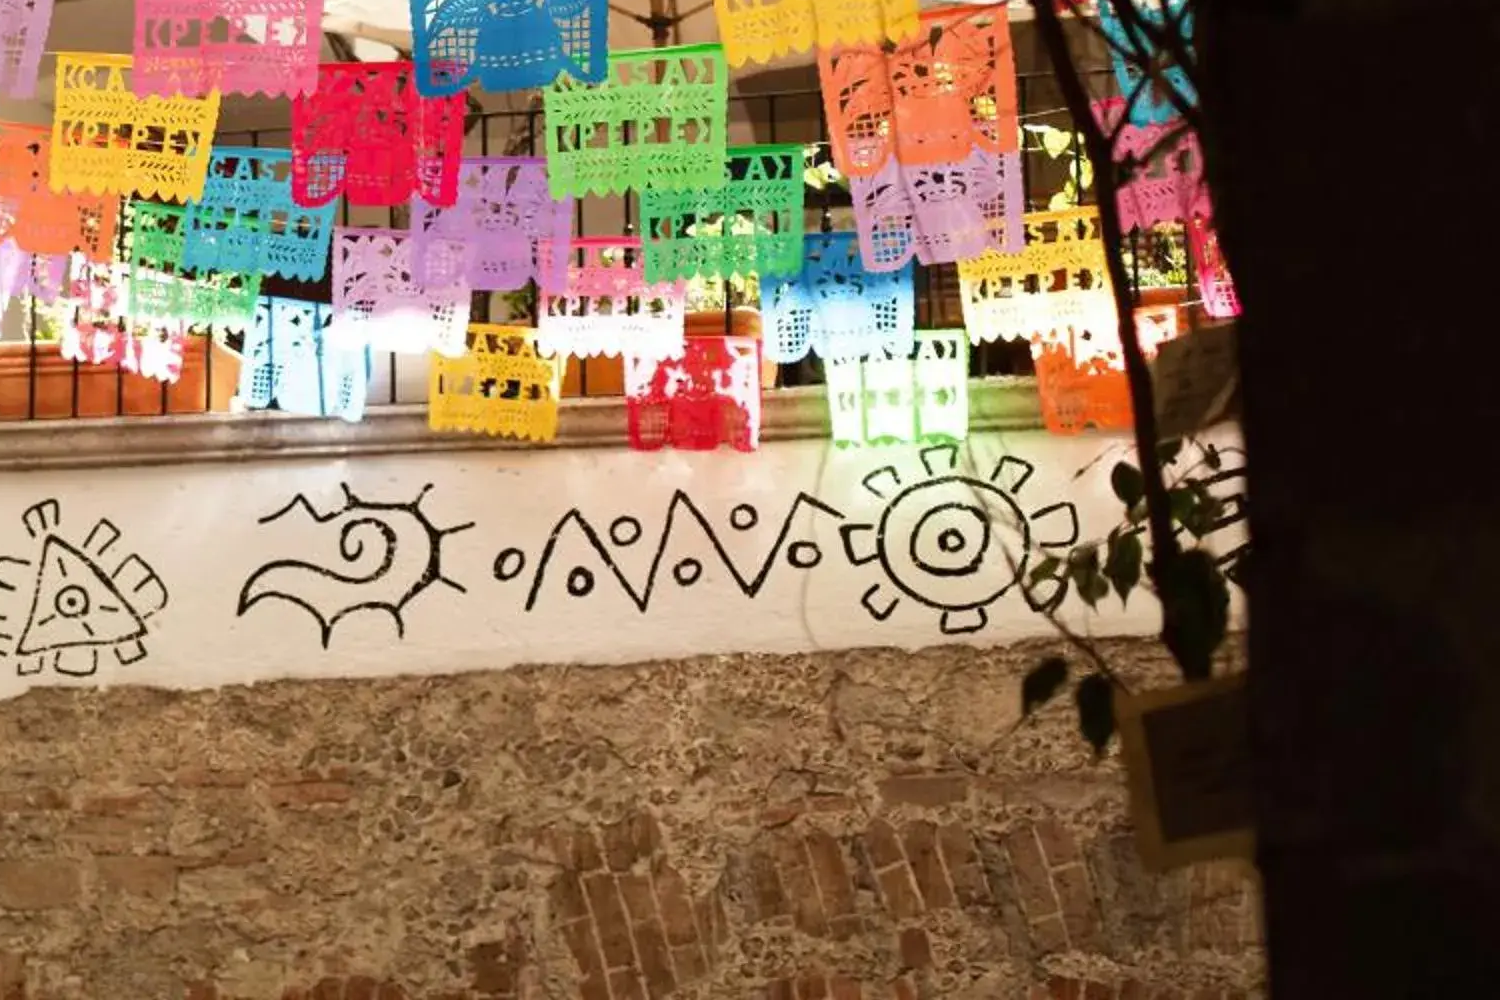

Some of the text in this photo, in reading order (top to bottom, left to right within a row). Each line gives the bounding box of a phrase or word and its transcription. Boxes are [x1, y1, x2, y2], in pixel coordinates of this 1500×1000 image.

[170, 14, 280, 48] PEPE
[608, 59, 688, 88] ASA
[84, 122, 178, 156] PEPE
[580, 117, 688, 150] PEPE
[210, 156, 280, 183] CAS
[671, 210, 771, 240] PEPE
[1028, 219, 1077, 245] SA
[987, 268, 1082, 299] PEPE
[566, 294, 653, 318] PEPE
[474, 332, 536, 357] ASA
